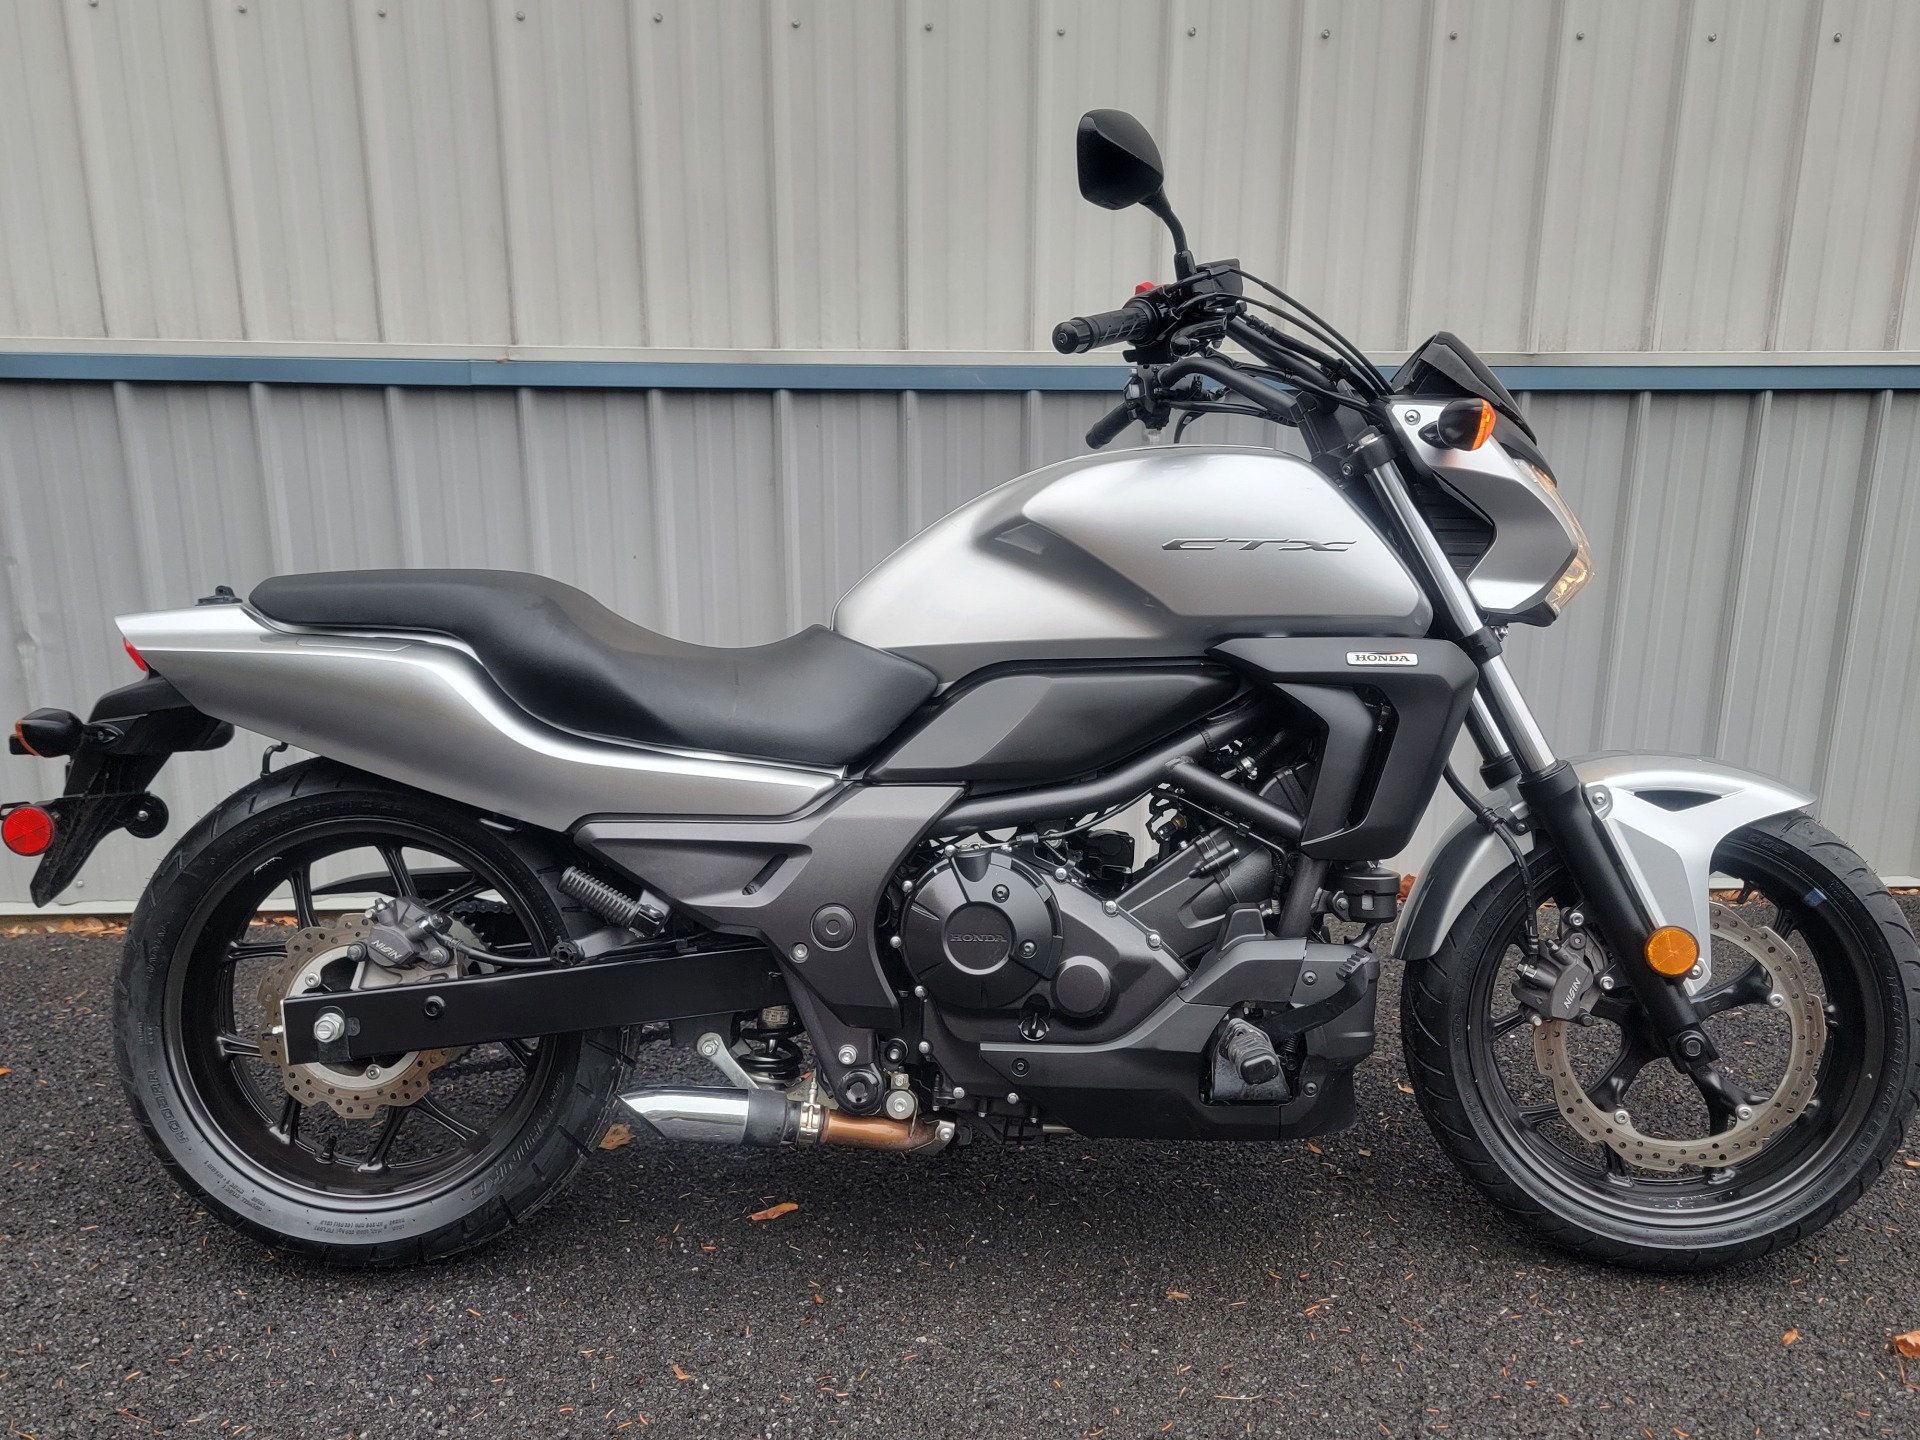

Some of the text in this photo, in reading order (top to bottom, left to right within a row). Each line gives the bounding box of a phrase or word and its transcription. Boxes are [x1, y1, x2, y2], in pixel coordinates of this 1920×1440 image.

[1161, 537, 1357, 552] CTX
[1355, 654, 1411, 662] HONDA
[950, 933, 1007, 943] HONDA
